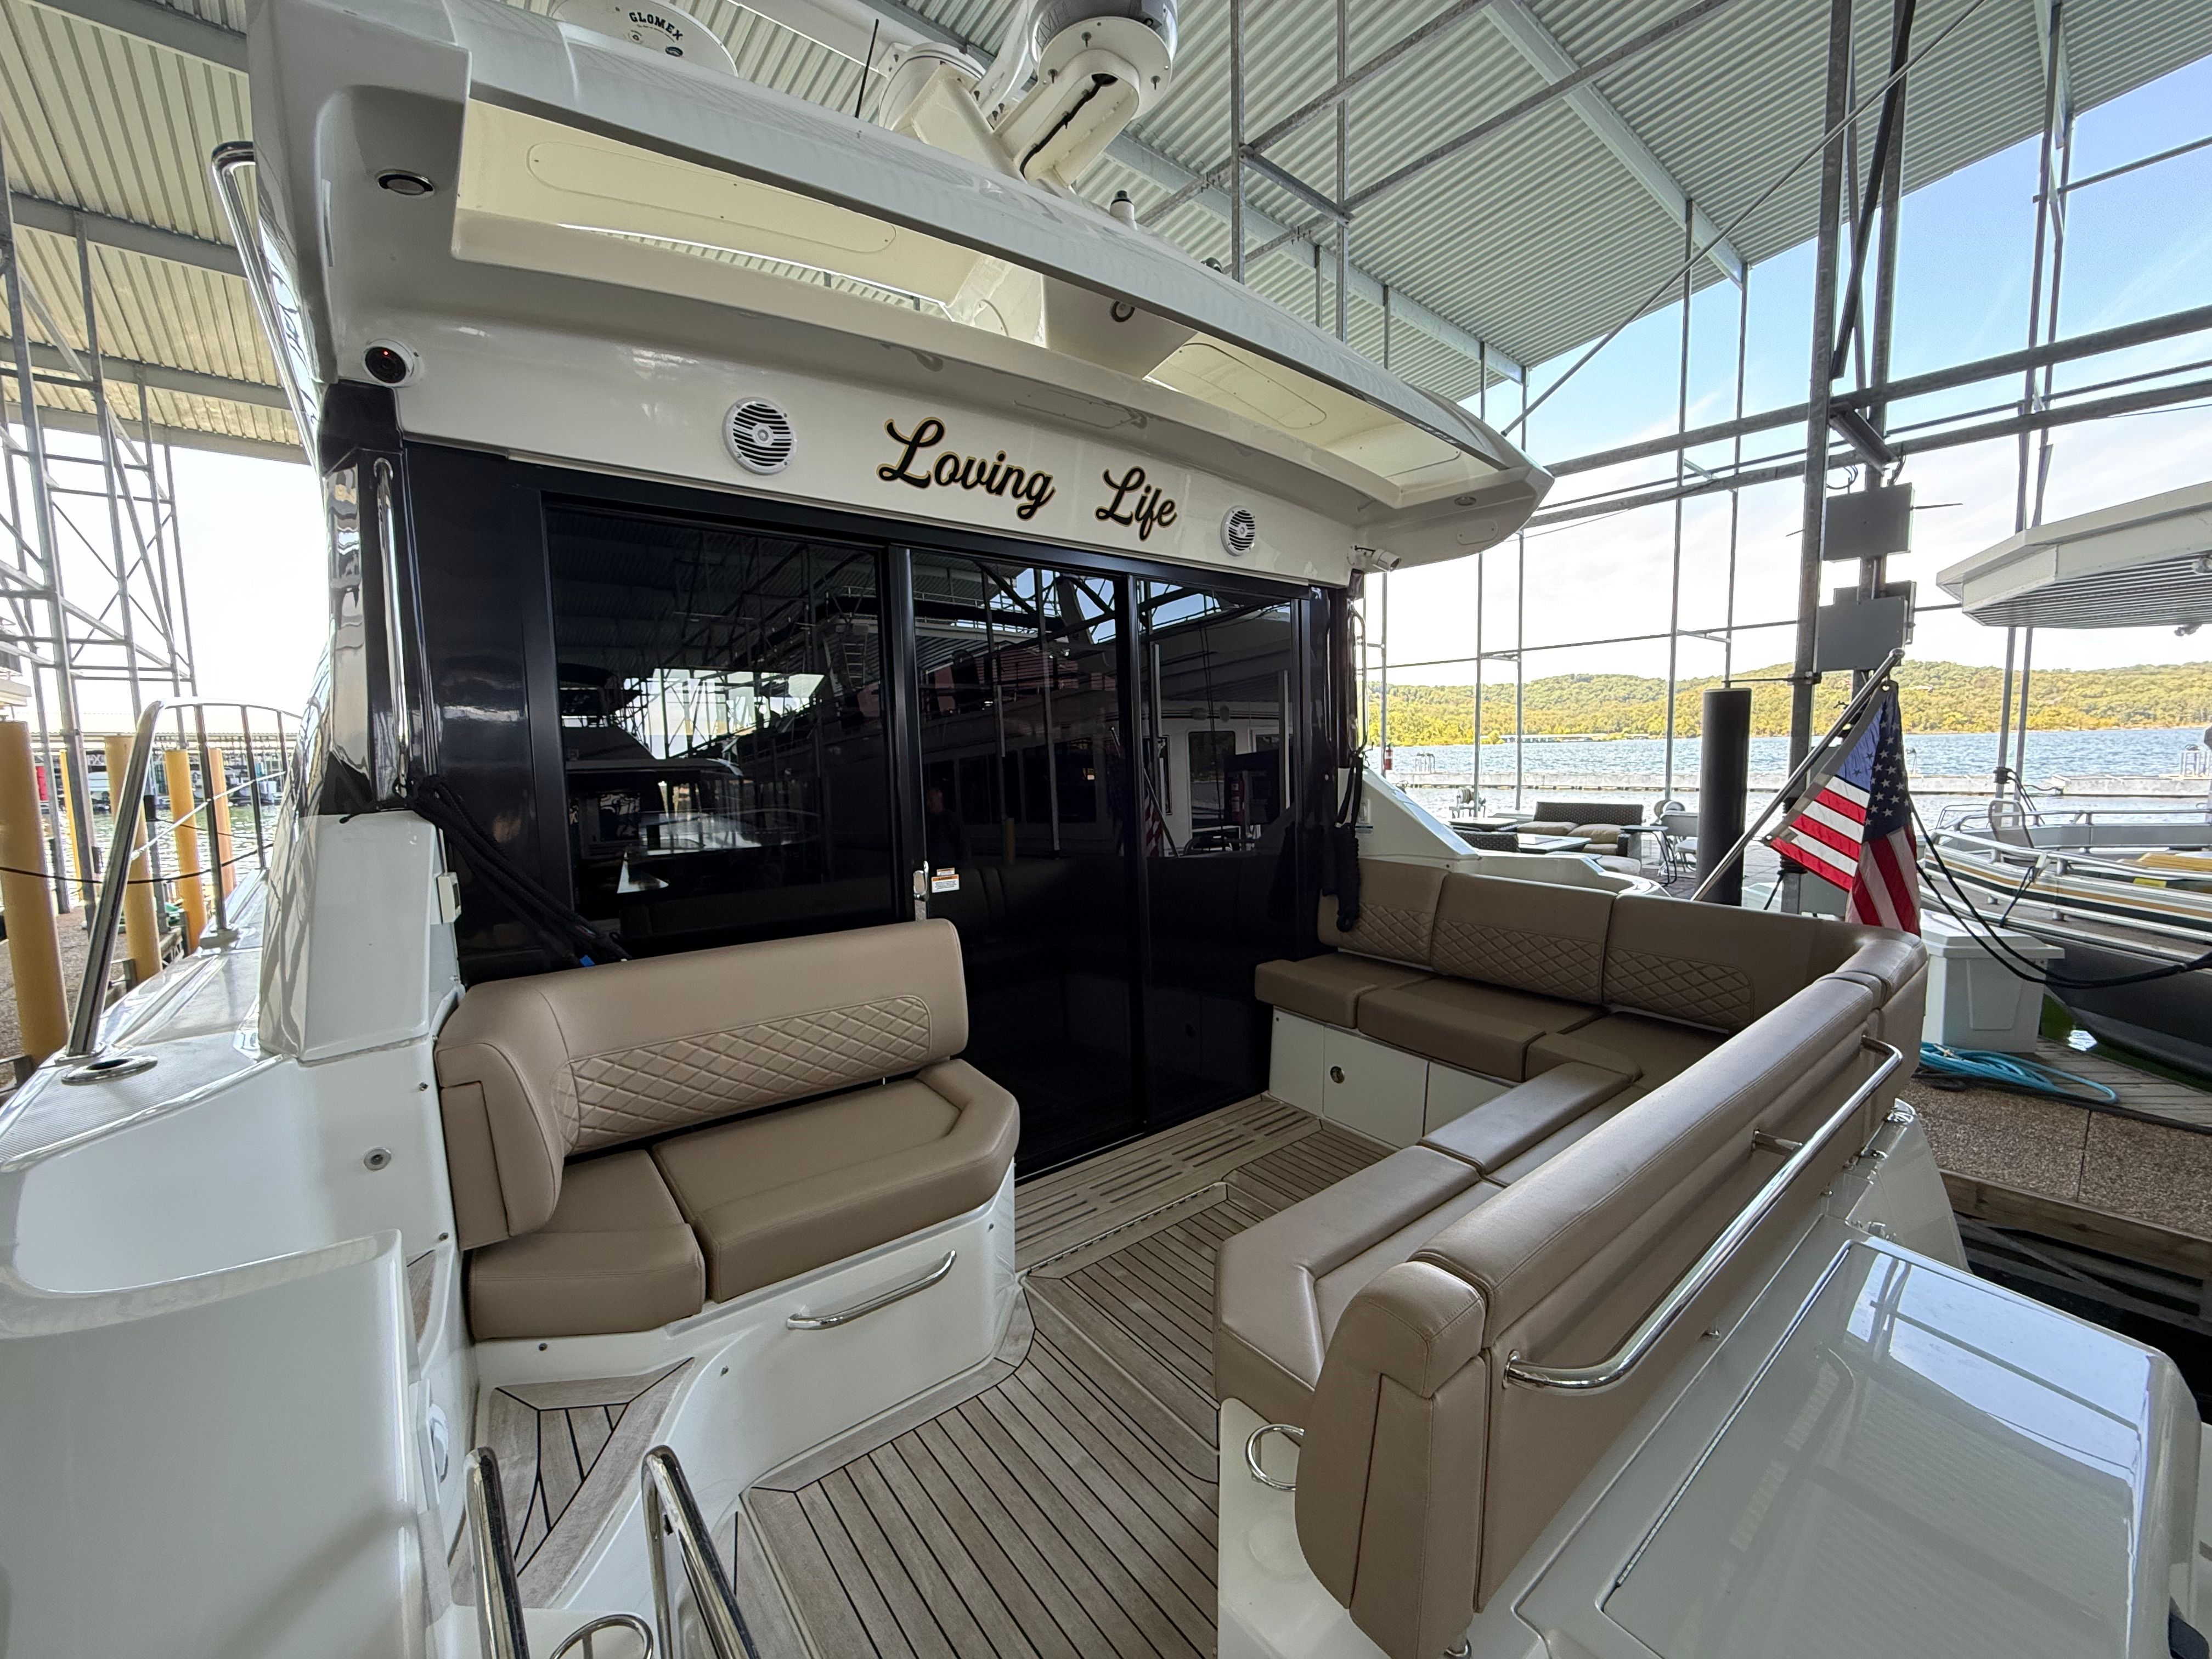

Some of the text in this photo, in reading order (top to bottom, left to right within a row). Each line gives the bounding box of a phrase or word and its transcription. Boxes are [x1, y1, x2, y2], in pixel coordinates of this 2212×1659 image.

[629, 12, 683, 41] GLOMEX
[877, 416, 1177, 541] Loving Life
